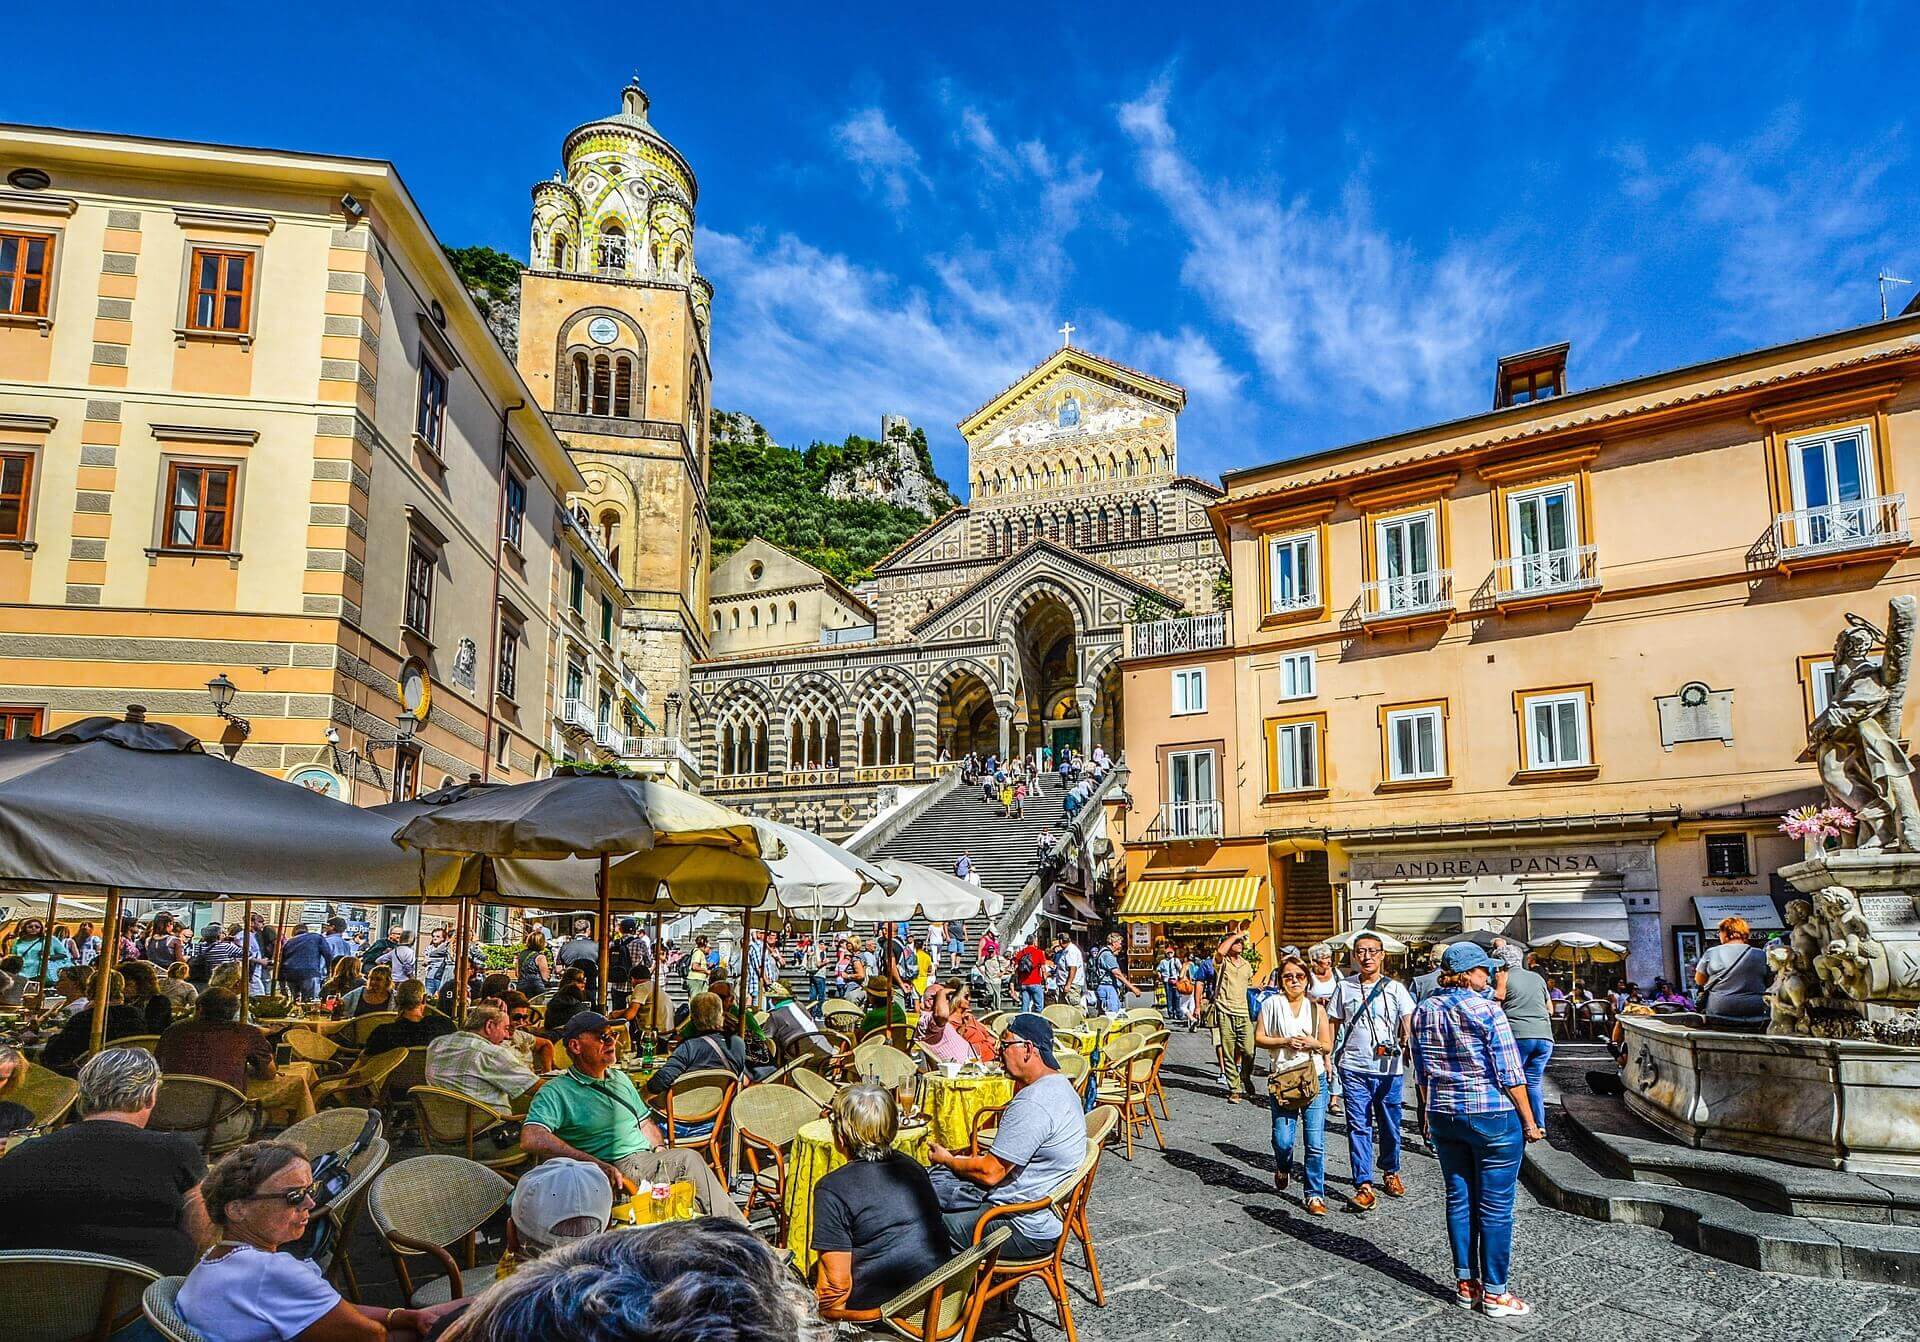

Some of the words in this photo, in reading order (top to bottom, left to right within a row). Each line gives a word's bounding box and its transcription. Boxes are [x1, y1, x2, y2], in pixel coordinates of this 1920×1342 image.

[1395, 860, 1490, 876] ANDREA
[1510, 855, 1600, 872] PANSA
[446, 990, 453, 999] 9
